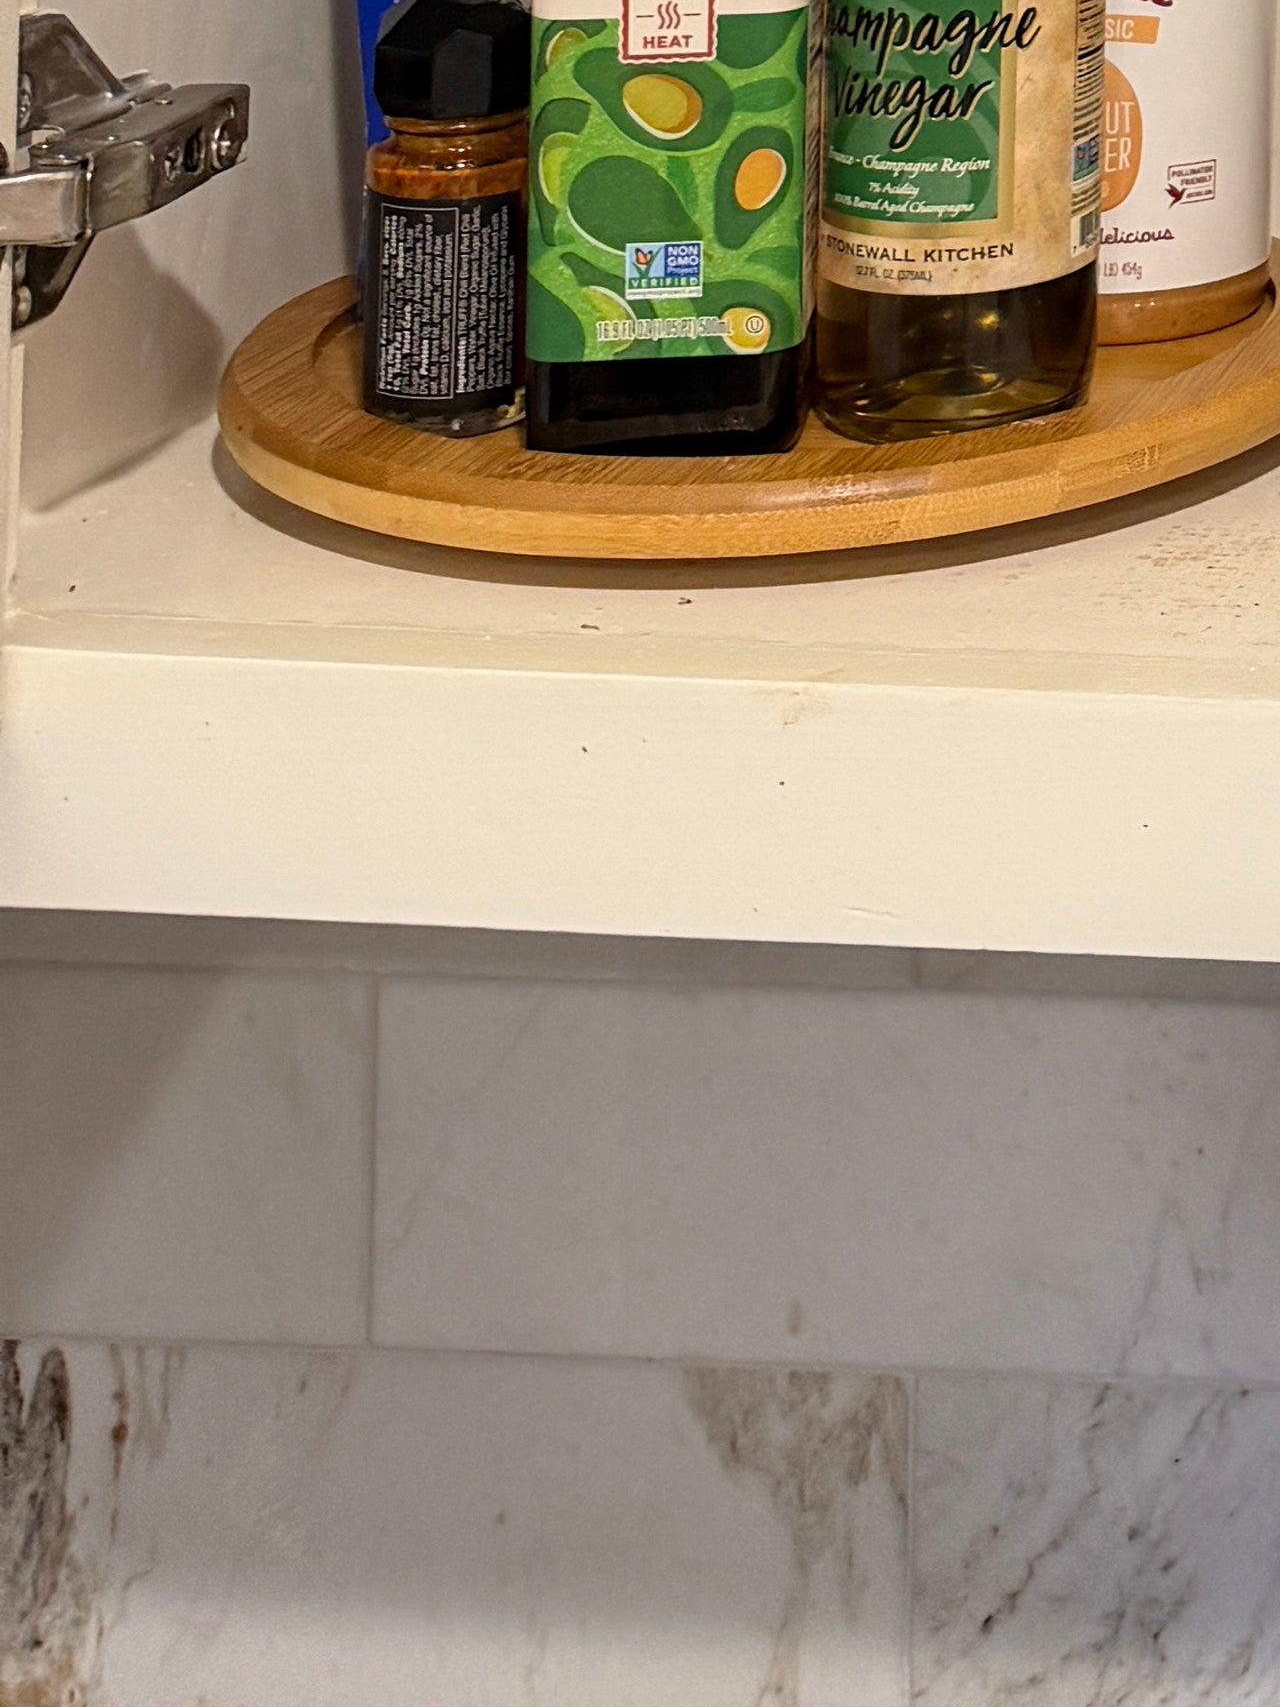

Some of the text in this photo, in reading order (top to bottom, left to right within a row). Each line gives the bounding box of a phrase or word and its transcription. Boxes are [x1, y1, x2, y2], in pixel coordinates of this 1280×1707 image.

[643, 35, 693, 49] HEAT
[829, 6, 1042, 77] ampagne
[835, 68, 994, 151] Vinegar
[863, 155, 990, 178] Champagne Region
[668, 246, 698, 255] NON
[827, 235, 1014, 262] STONEWALL KITCHEN
[668, 256, 699, 266] GMO
[631, 278, 699, 287] VERIFIED
